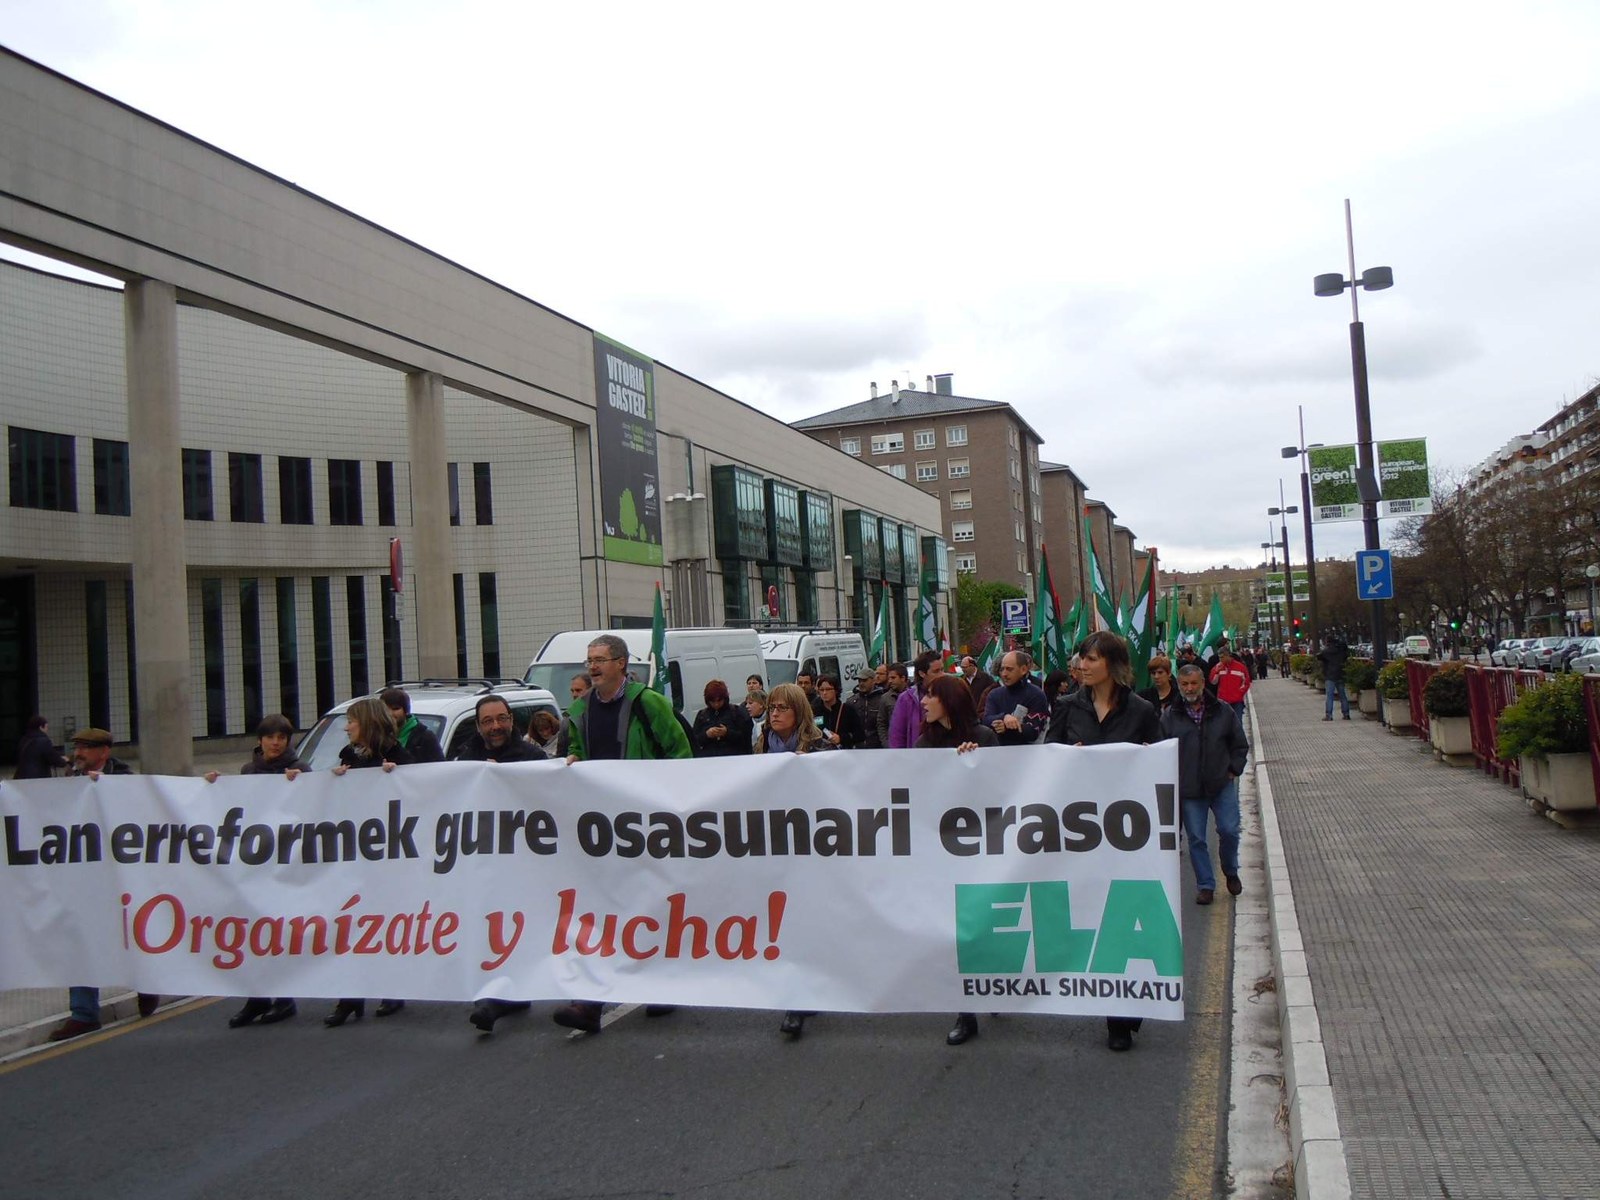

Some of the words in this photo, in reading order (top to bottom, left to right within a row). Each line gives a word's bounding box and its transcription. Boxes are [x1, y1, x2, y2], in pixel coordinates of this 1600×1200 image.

[606, 353, 645, 394] VITORIA
[608, 381, 647, 419] GASTEIZ
[1320, 505, 1341, 513] VITORIA
[1389, 499, 1411, 507] VITORIA
[1363, 555, 1384, 581] P
[1006, 602, 1023, 621] P
[3, 814, 102, 866] Lan
[111, 799, 419, 866] erreformek
[433, 808, 558, 875] gure
[576, 788, 911, 860] osasunari
[939, 783, 1178, 857] eraso!
[480, 910, 525, 972] y
[552, 888, 788, 961] lucha!
[954, 879, 1183, 977] ELA
[962, 977, 1051, 997] EUSKAL
[1058, 977, 1184, 1002] SINDIKATU
